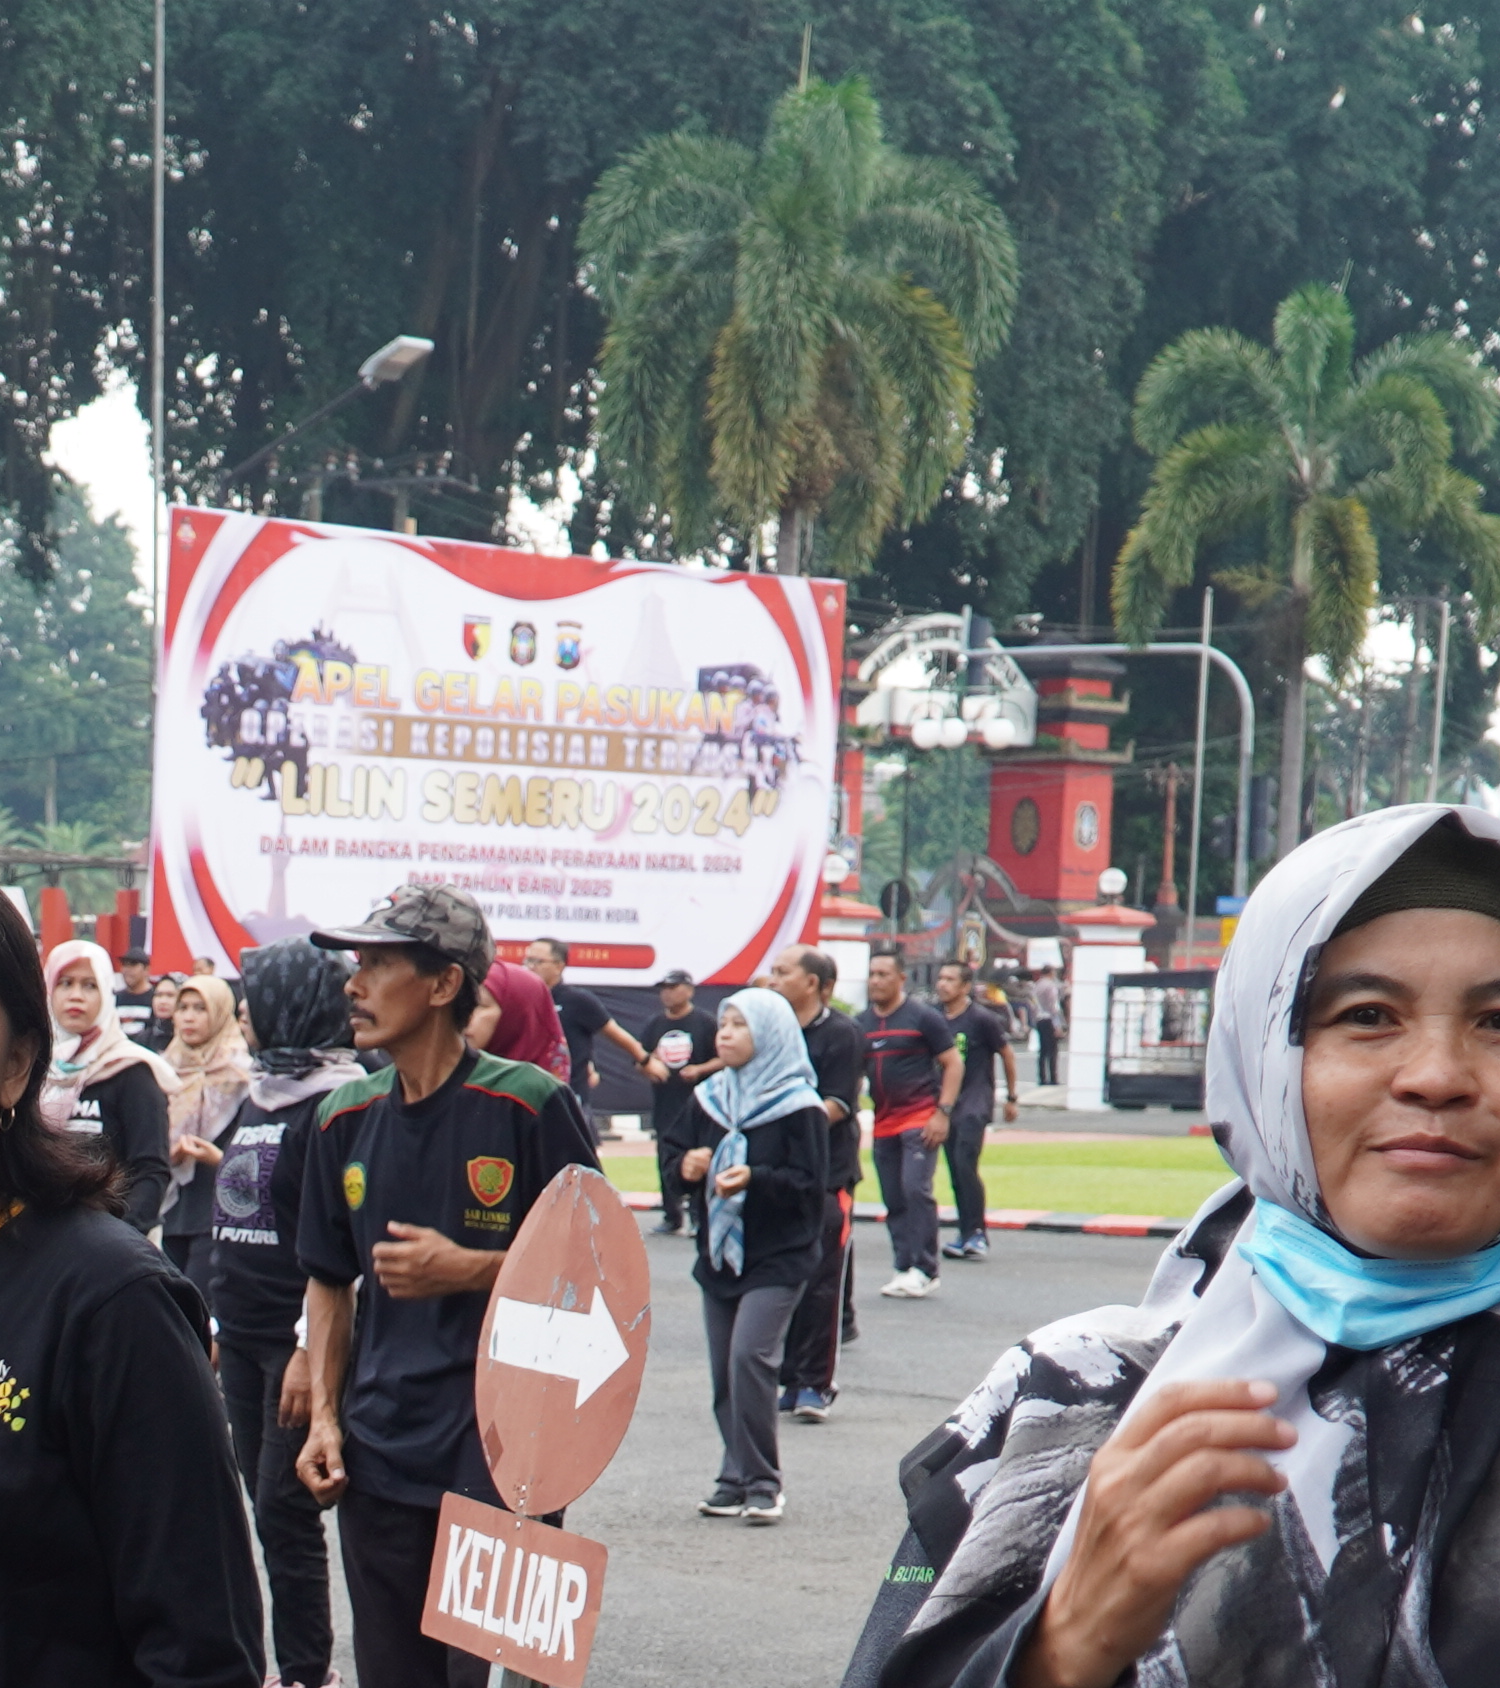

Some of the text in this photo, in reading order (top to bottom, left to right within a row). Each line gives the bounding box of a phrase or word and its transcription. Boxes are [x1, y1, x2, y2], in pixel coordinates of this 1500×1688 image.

[291, 659, 746, 733] APEL GELAR PASUKAN
[239, 708, 776, 777] OPERASI KEPOLISIAN TERPUSAT
[421, 769, 617, 831] SEMERU
[260, 836, 743, 873] DALAM RANGKA PENGAMANAN PERAYAAN NATAL 2024
[450, 872, 513, 894] TAHUN
[517, 875, 566, 895] BARU
[570, 877, 614, 898] 2025
[497, 904, 552, 921] POLRES
[604, 907, 640, 923] KOTA
[437, 1522, 588, 1662] KELUAR
[893, 1565, 936, 1583] BLITAR
